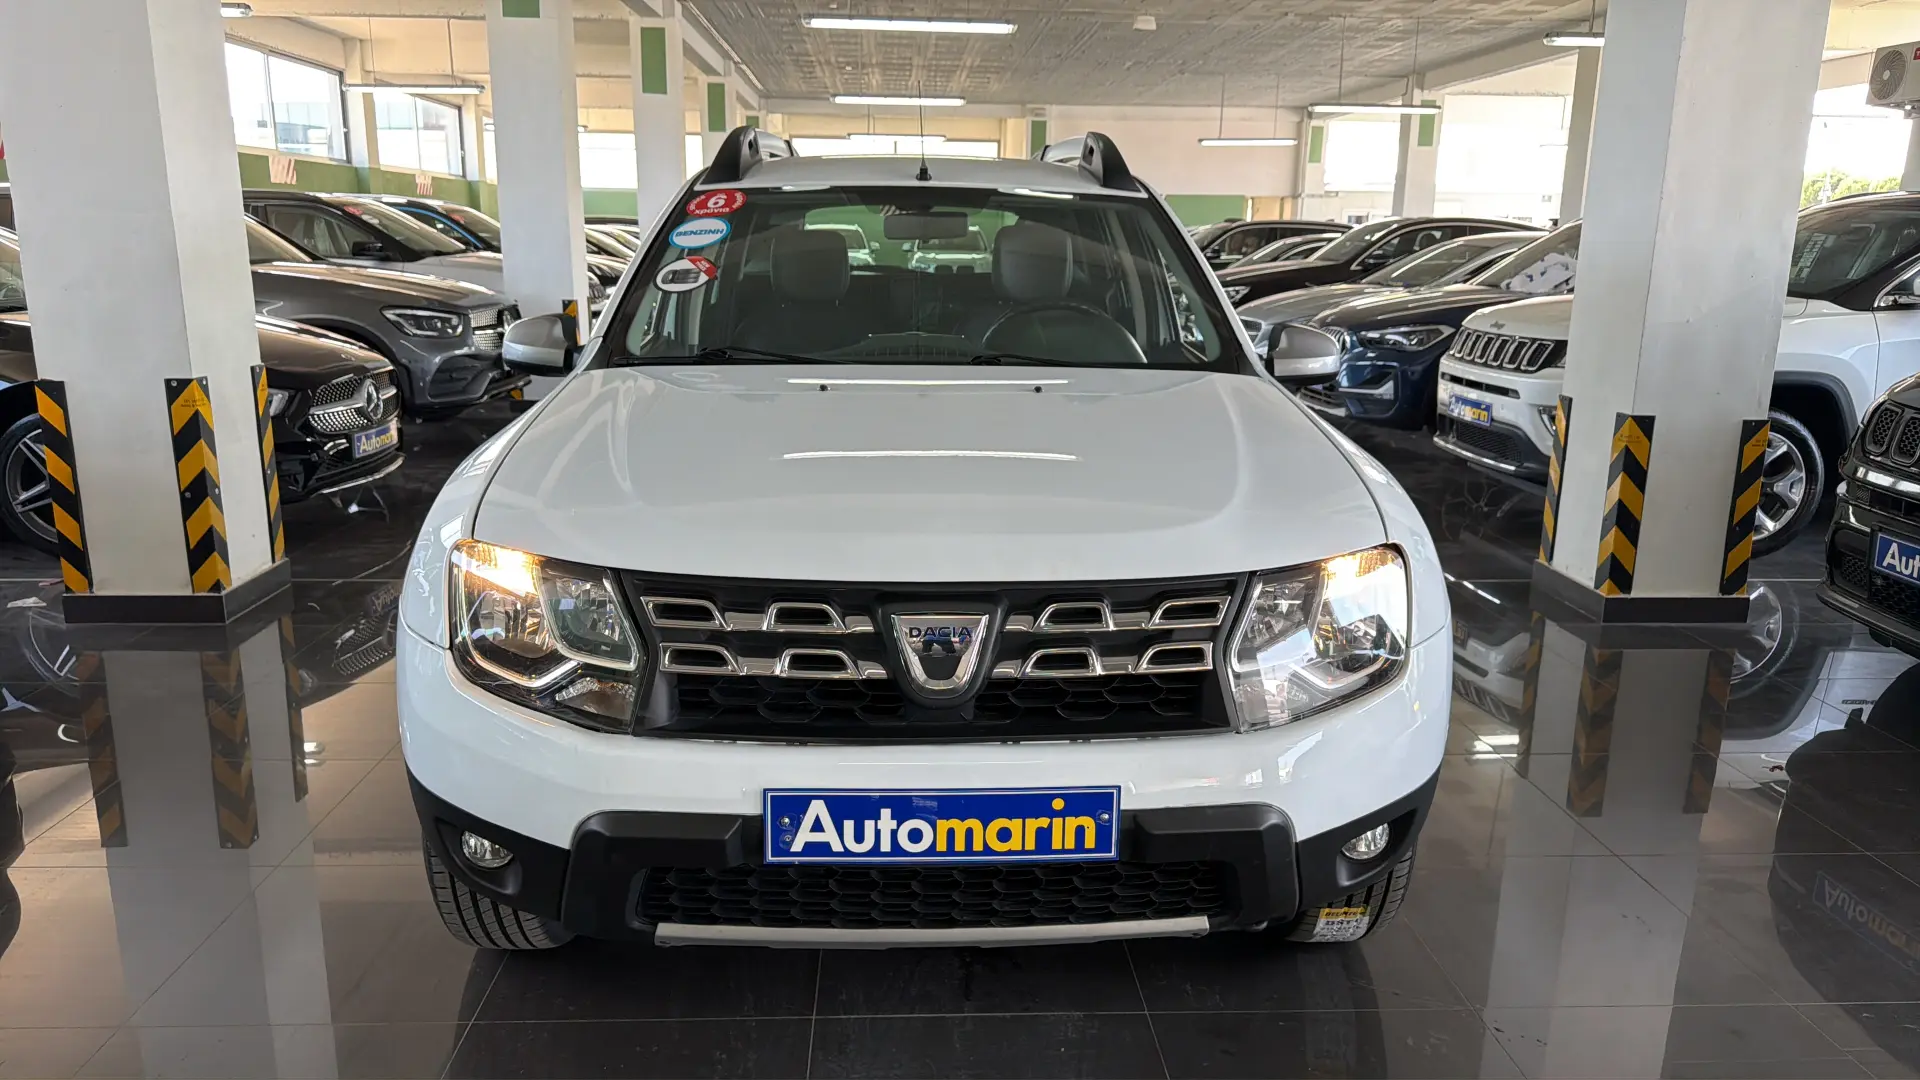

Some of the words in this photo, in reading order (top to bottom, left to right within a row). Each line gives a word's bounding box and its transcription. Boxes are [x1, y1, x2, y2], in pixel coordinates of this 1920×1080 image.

[707, 195, 727, 208] 6
[360, 432, 394, 454] Automar
[908, 626, 972, 639] DACIA
[789, 797, 1096, 853] Automarin
